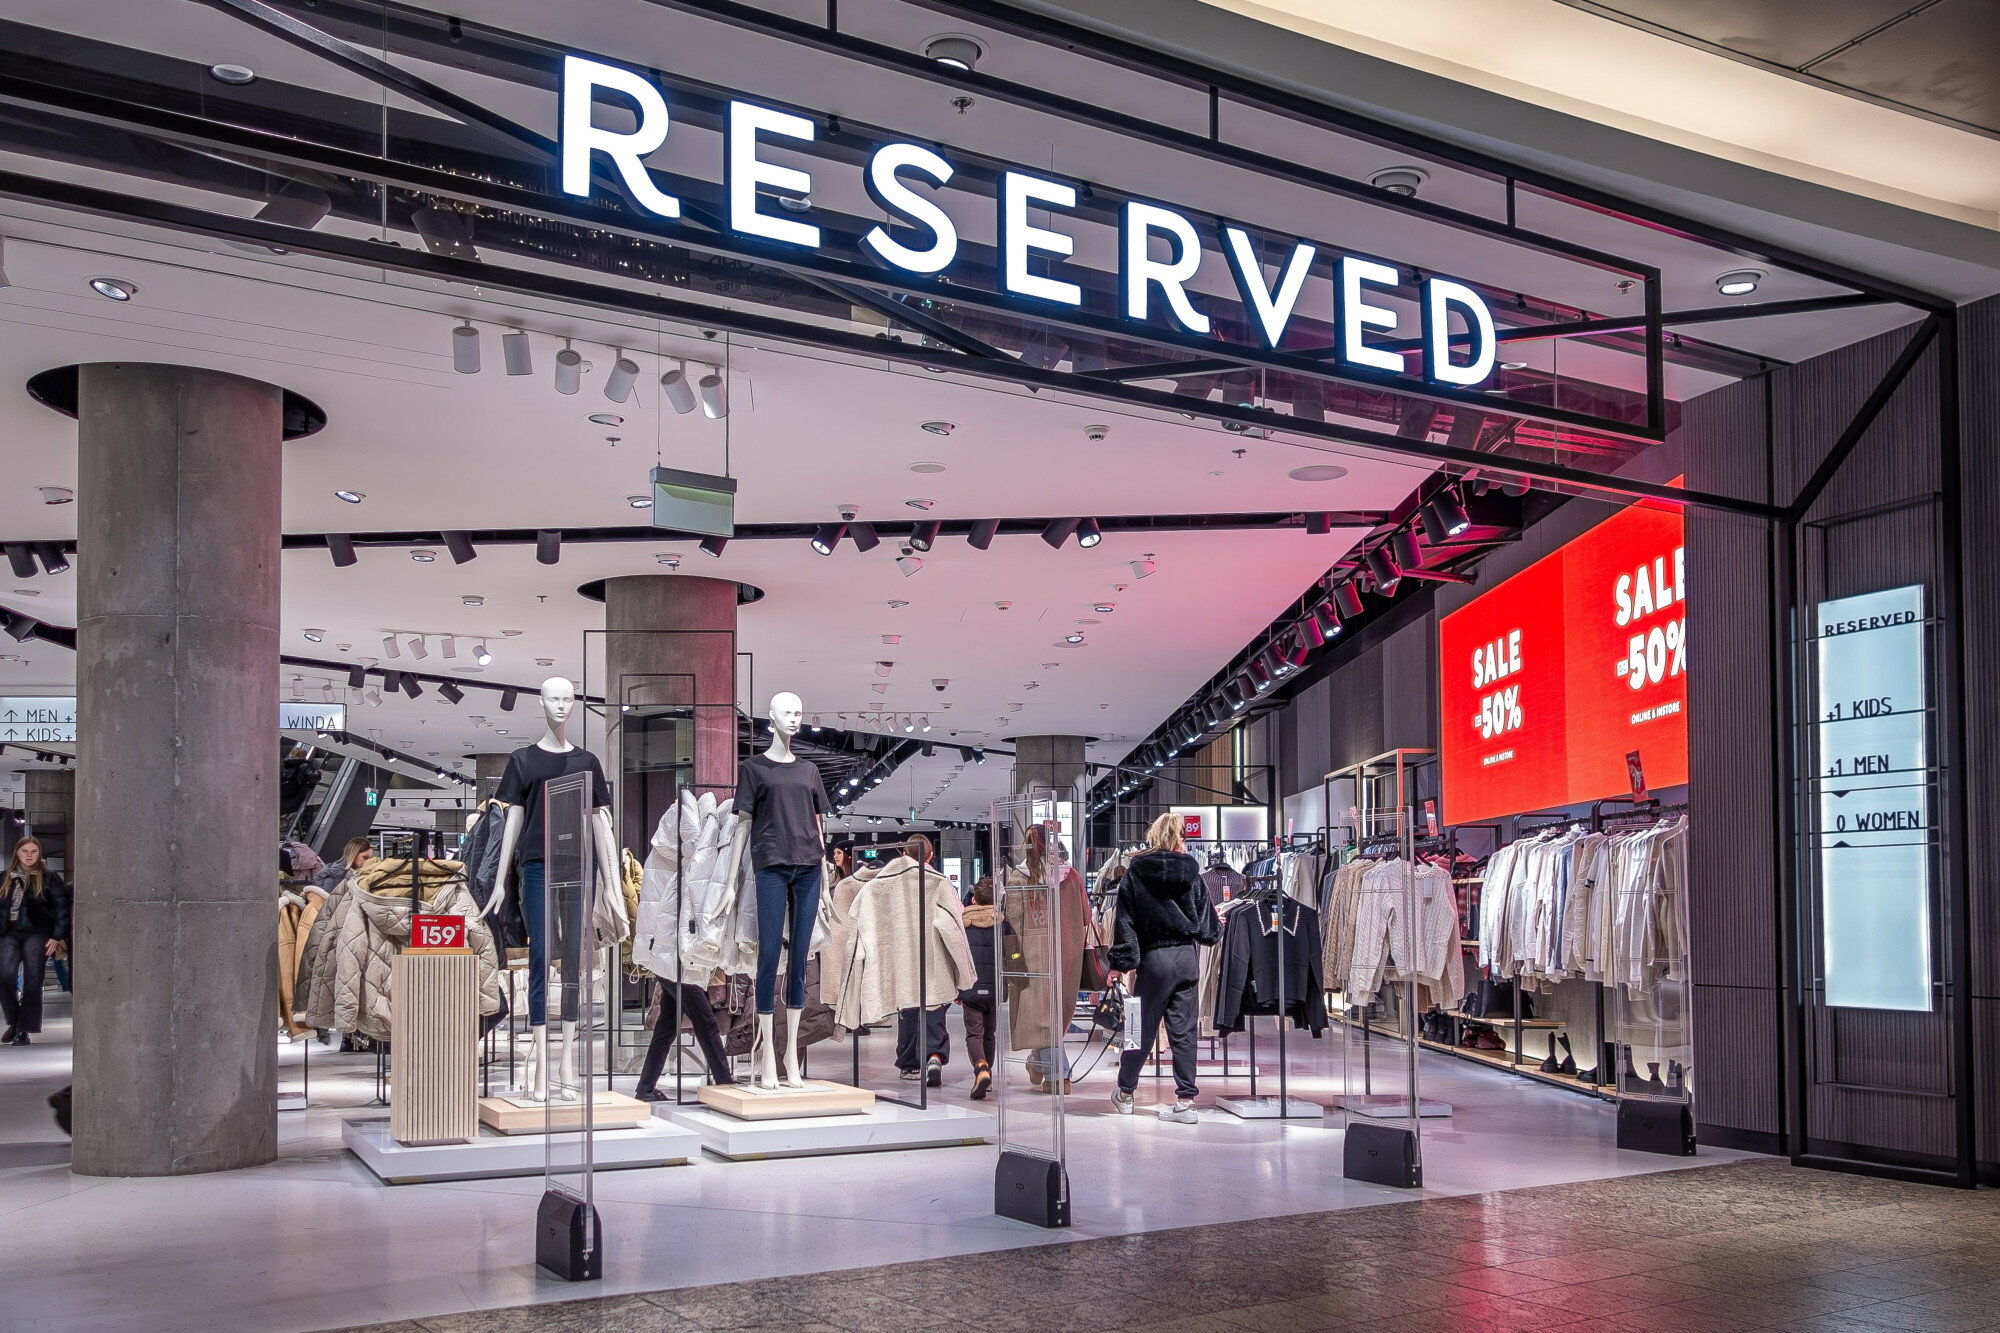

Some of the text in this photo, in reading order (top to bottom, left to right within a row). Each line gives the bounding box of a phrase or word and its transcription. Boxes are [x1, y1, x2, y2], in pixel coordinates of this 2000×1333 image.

[559, 55, 1498, 386] RESERVED
[1616, 546, 1685, 627] SALE
[1825, 610, 1916, 637] RESERVED
[1473, 629, 1521, 689] SALE
[26, 709, 58, 723] MEN
[1631, 709, 1652, 725] ONLINE
[1656, 701, 1680, 717] INSTORE
[1826, 696, 1892, 721] +1 KIDS
[287, 715, 336, 730] WINDA
[26, 728, 61, 742] KIDS
[1827, 754, 1889, 777] +1 MEN
[1186, 822, 1200, 833] 89
[1836, 810, 1919, 832] 0 WOMEN
[420, 925, 456, 945] 159
